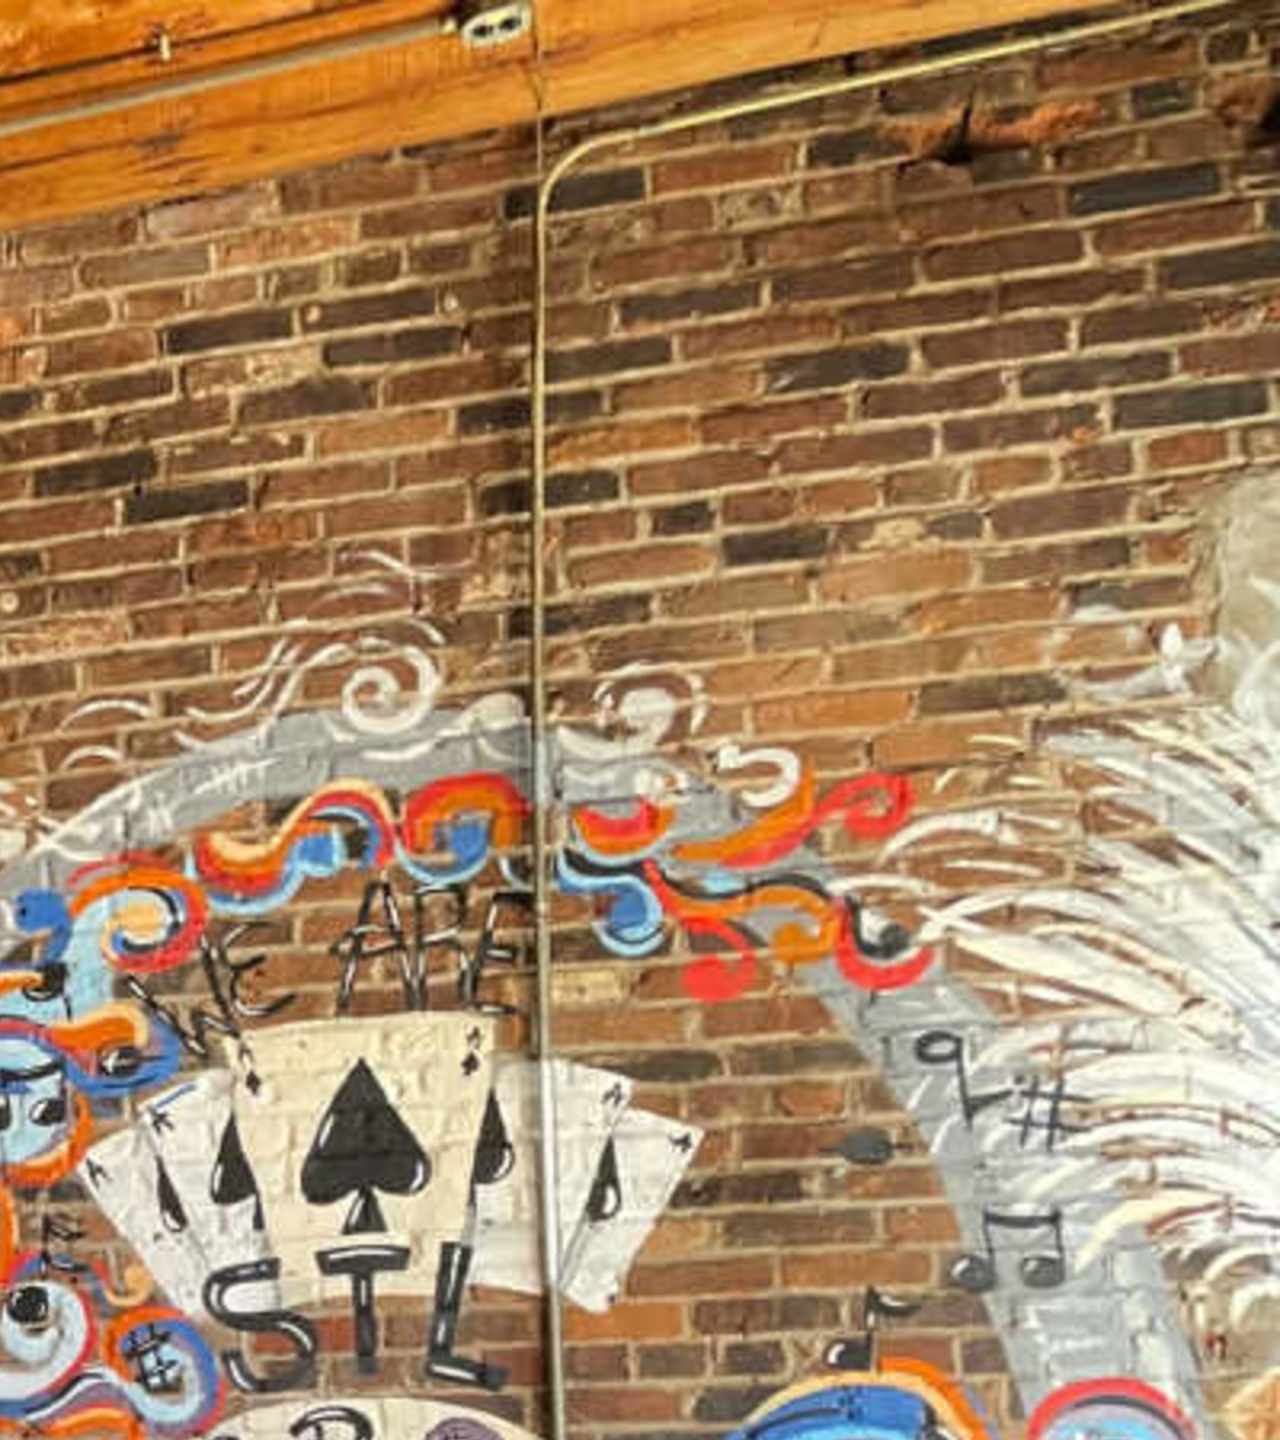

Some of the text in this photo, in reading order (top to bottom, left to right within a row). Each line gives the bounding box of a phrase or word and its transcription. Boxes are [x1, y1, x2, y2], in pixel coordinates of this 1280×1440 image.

[127, 880, 534, 1057] WE ARE
[200, 1239, 511, 1394] STL
